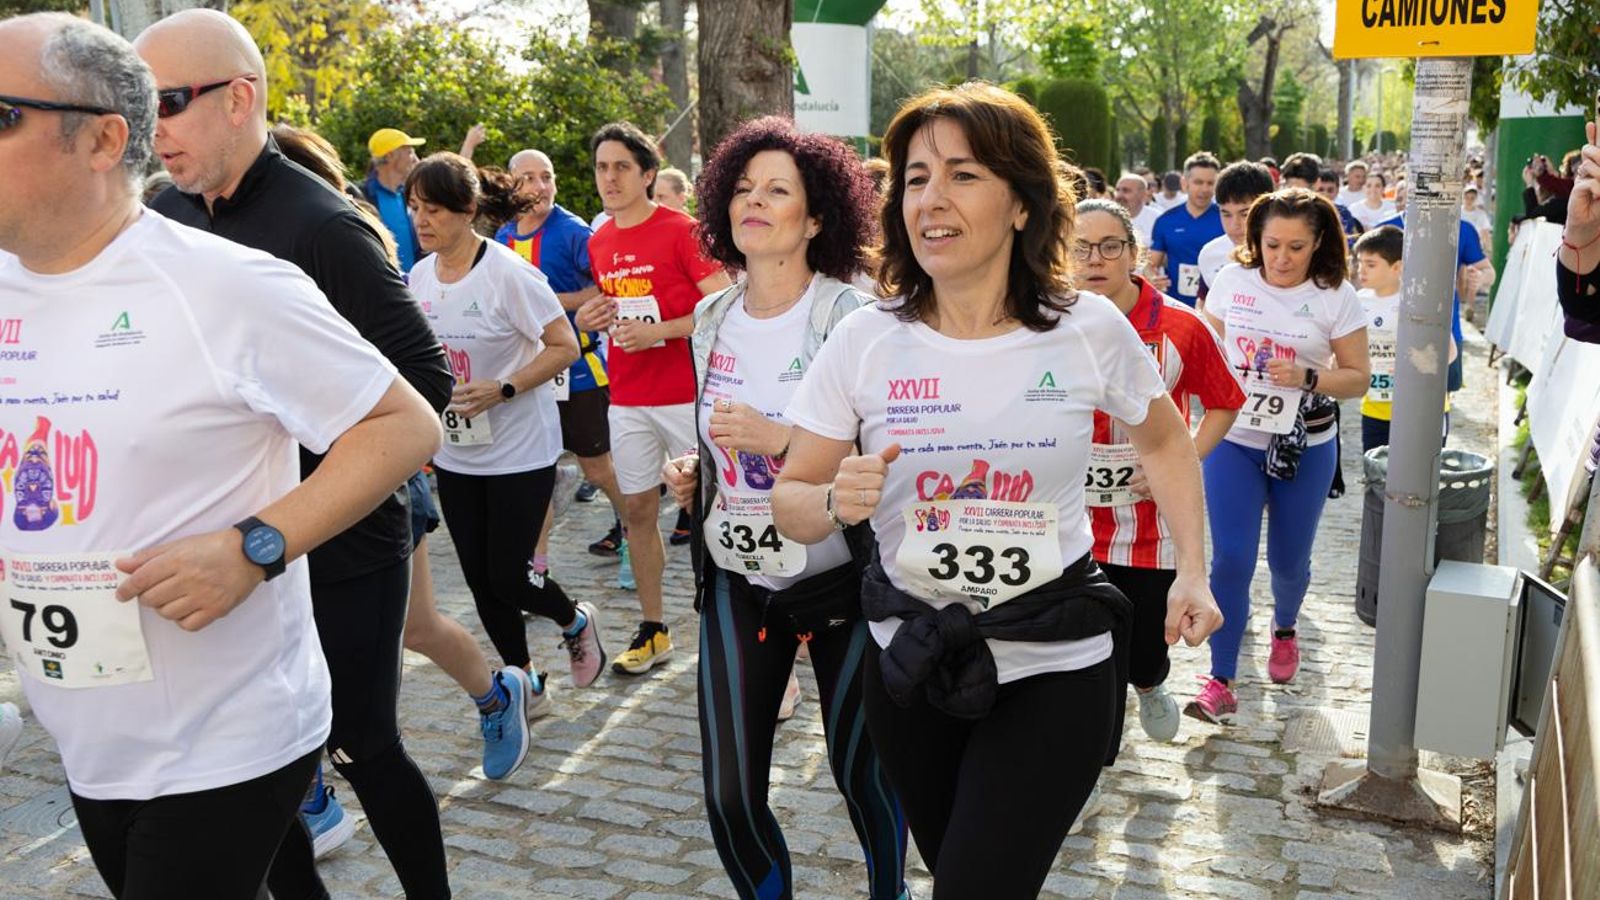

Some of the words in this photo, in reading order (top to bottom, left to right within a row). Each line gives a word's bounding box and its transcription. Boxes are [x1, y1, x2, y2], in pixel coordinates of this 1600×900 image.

[1361, 0, 1506, 28] CAMIONES
[794, 100, 839, 112] ndalucía
[0, 319, 22, 344] VII
[887, 378, 941, 401] XXVII
[1370, 374, 1394, 389] 25
[886, 405, 920, 415] CARRERA
[921, 403, 962, 414] POPULAR
[1248, 392, 1284, 415] 79
[918, 442, 935, 453] cada
[937, 445, 955, 453] paso
[1011, 442, 1024, 450] por
[1027, 440, 1036, 449] tu
[1039, 437, 1057, 449] salud
[0, 428, 99, 523] ALUD
[963, 506, 984, 517] XXVII
[986, 507, 1013, 518] CARRERA
[1014, 509, 1045, 519] POPULAR
[718, 521, 783, 553] 334
[69, 560, 111, 572] POPULAR
[928, 542, 1031, 586] 333
[961, 585, 997, 596] AMPARO
[10, 598, 78, 649] 79
